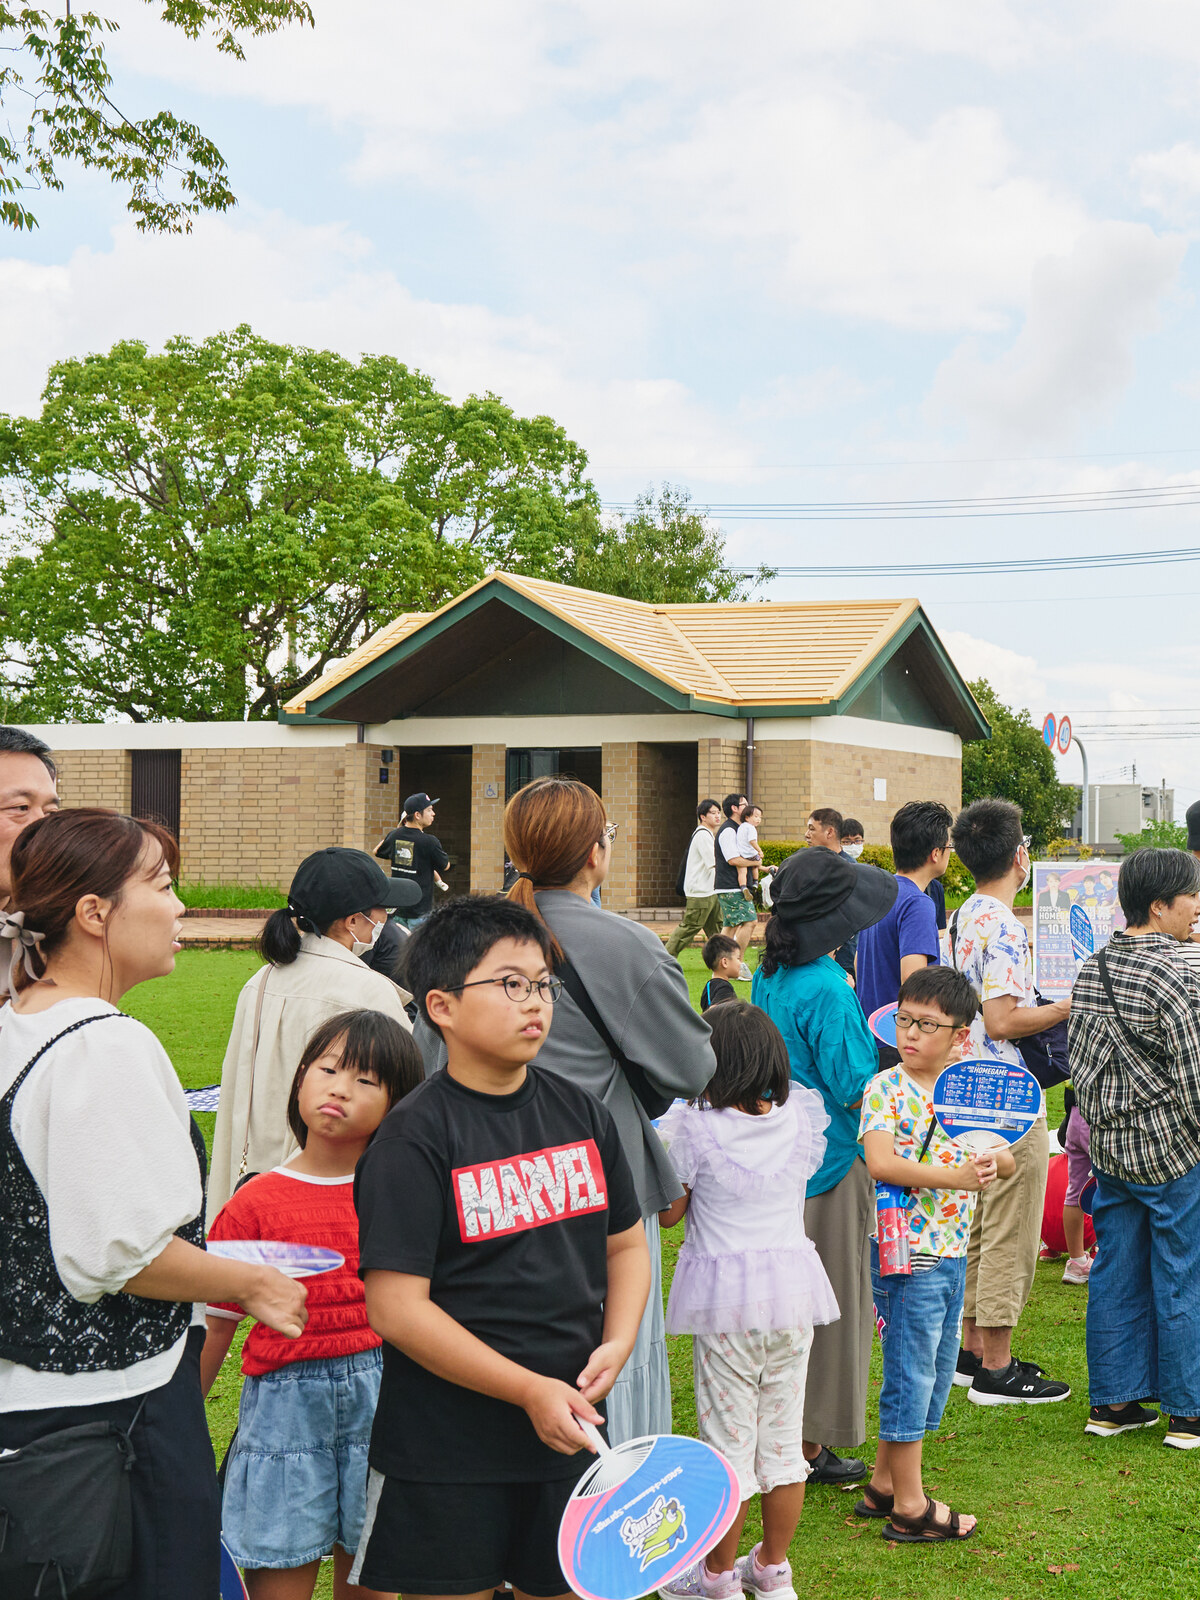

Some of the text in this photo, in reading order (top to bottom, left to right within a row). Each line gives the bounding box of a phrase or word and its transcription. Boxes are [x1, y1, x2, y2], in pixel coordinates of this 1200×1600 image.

[1060, 727, 1069, 744] 40
[973, 1066, 1008, 1076] HOMEGAME
[458, 1146, 605, 1237] MARVEL
